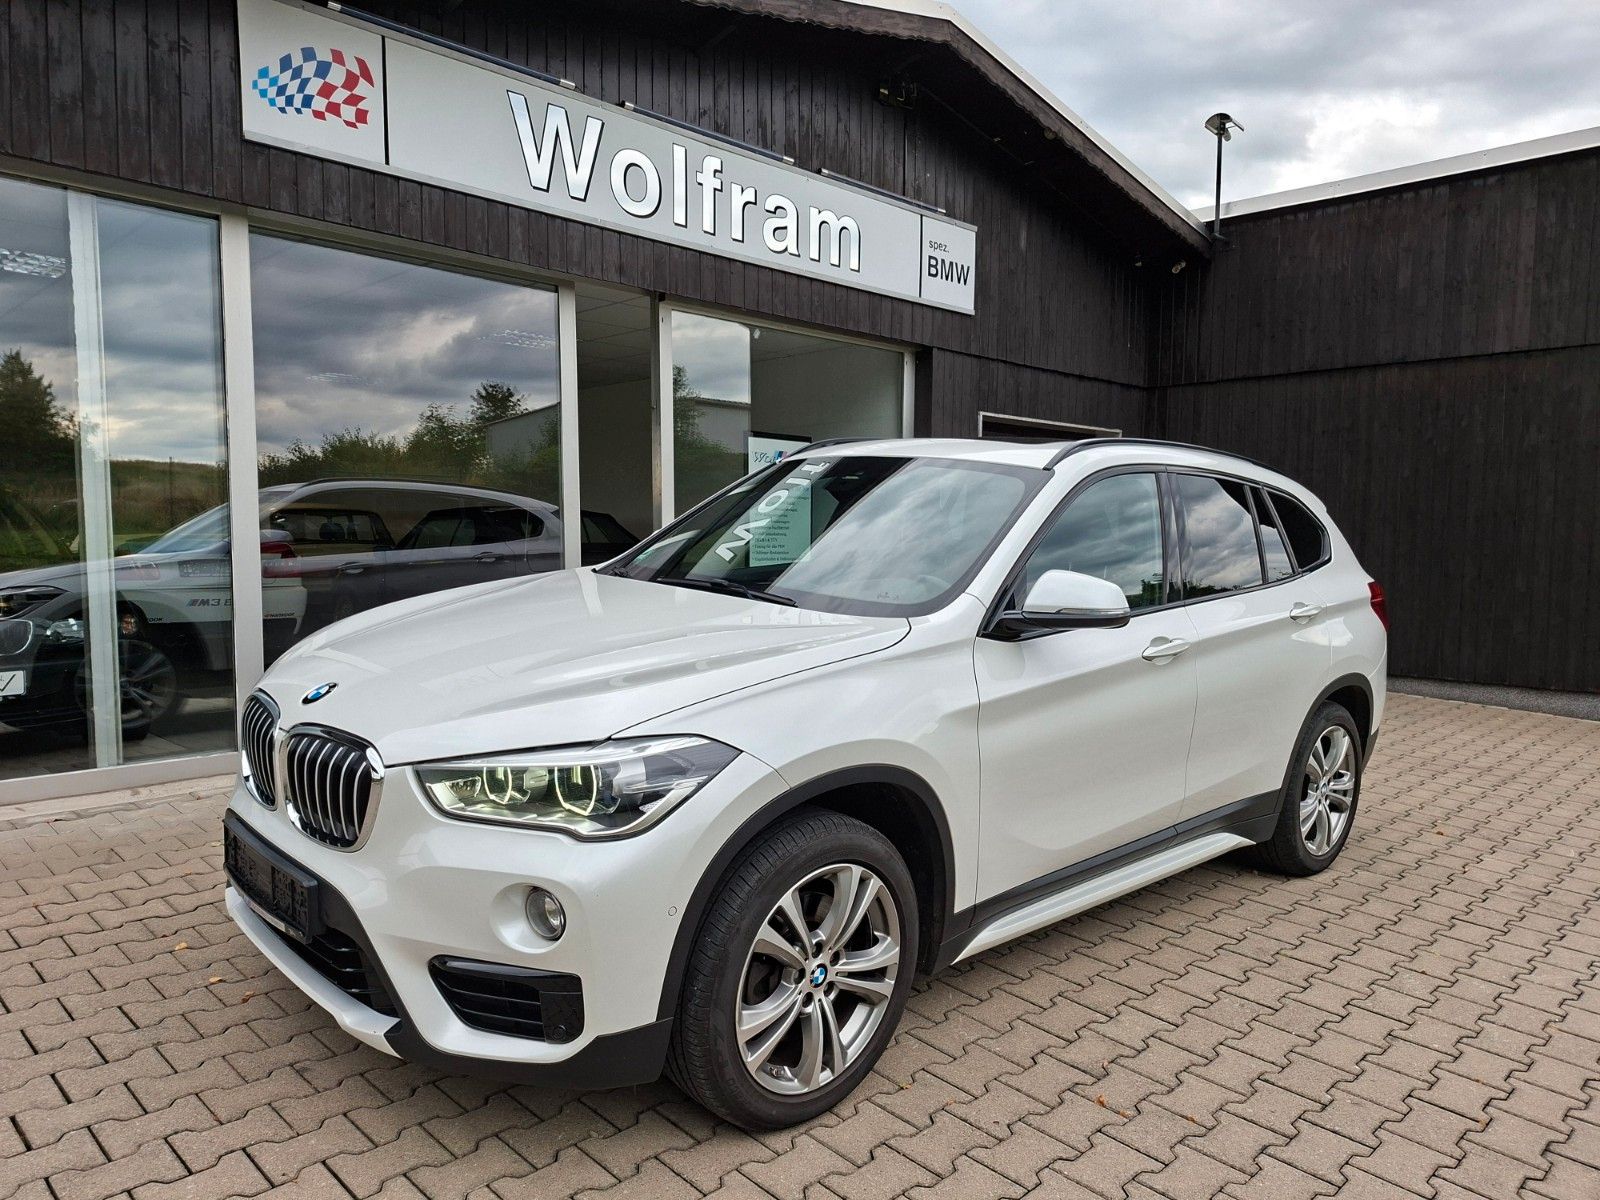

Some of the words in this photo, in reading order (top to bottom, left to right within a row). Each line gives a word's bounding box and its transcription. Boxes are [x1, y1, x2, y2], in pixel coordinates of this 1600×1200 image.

[507, 89, 861, 273] Wolfram
[928, 240, 950, 253] spez.
[928, 255, 971, 286] BMW
